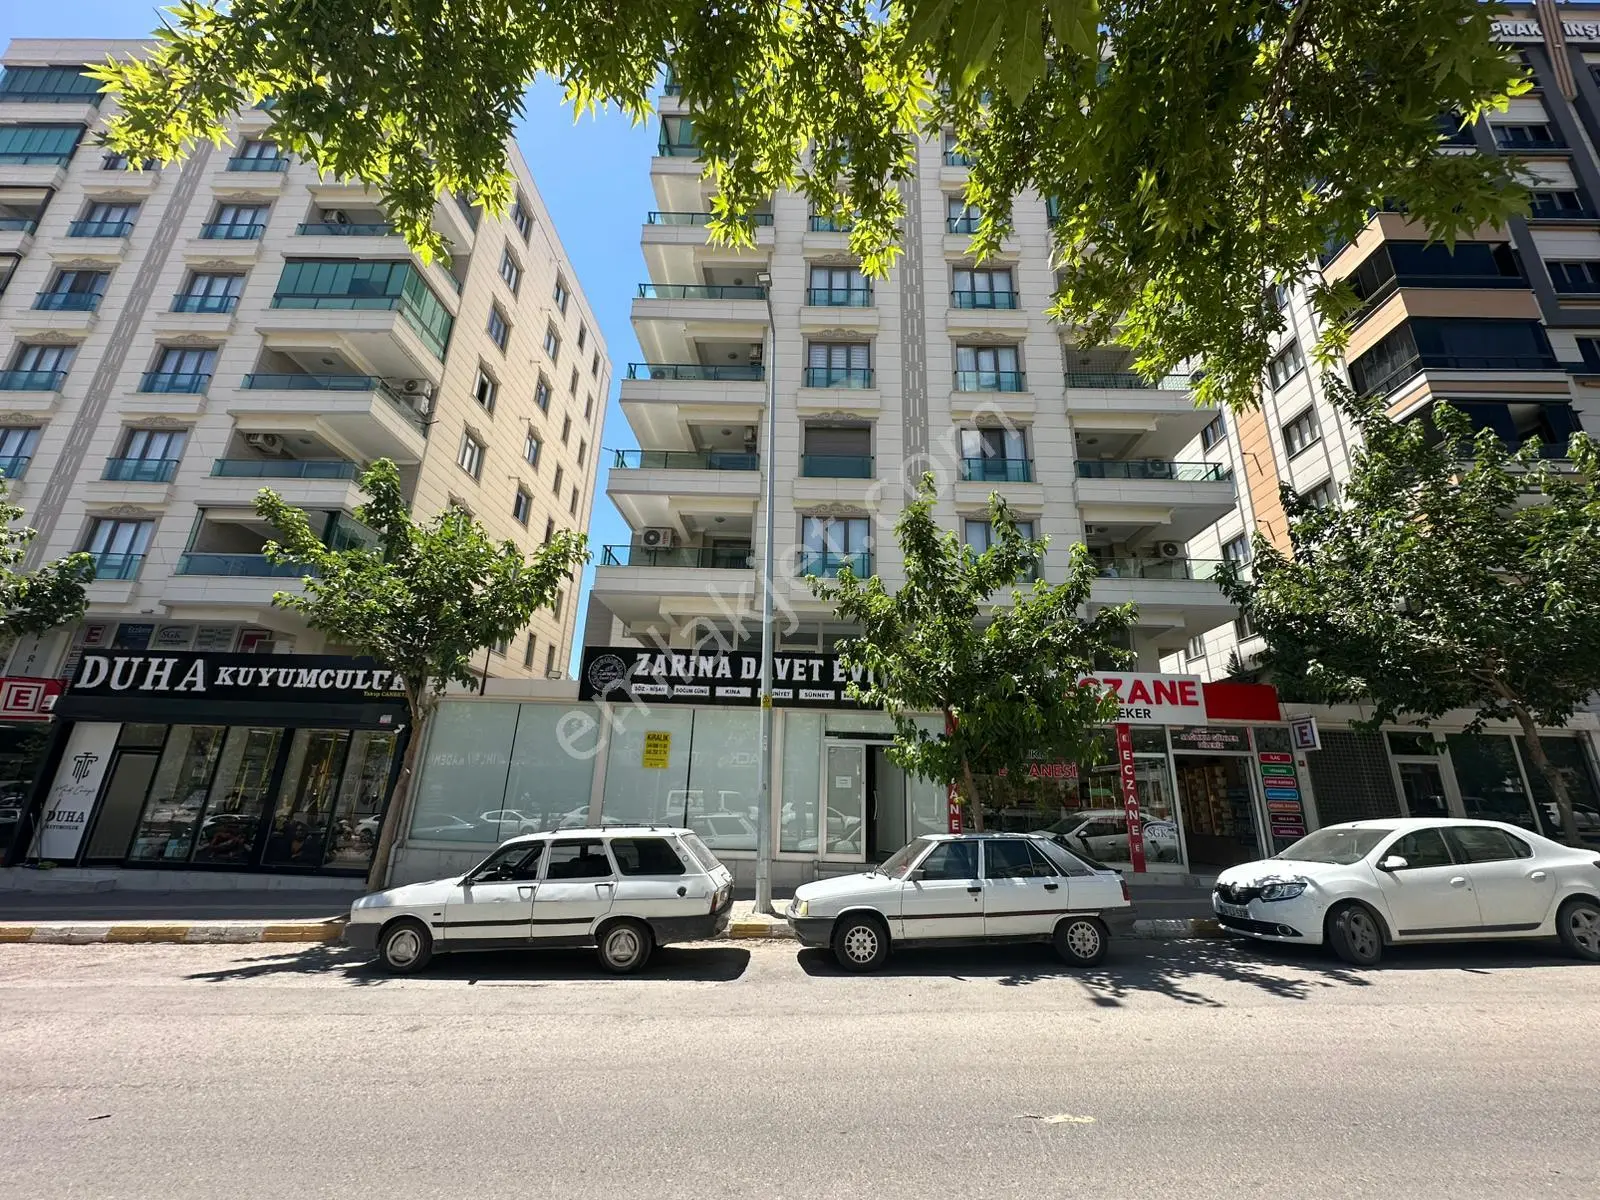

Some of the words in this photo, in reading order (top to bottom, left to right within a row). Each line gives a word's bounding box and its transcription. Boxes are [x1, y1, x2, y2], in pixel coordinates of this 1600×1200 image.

[1489, 22, 1543, 37] PRAK
[1562, 20, 1600, 40] İNŞ
[74, 654, 207, 692] DUHA
[633, 653, 733, 679] ZARİNA
[740, 656, 825, 682] DVET
[759, 688, 791, 697] UNİYET
[1062, 677, 1200, 706] ZANE
[1115, 708, 1152, 721] EKER
[997, 760, 1079, 778] EANESİ
[1122, 750, 1140, 836] ECZANE
[46, 810, 85, 823] DUHA
[1147, 827, 1168, 838] SGK
